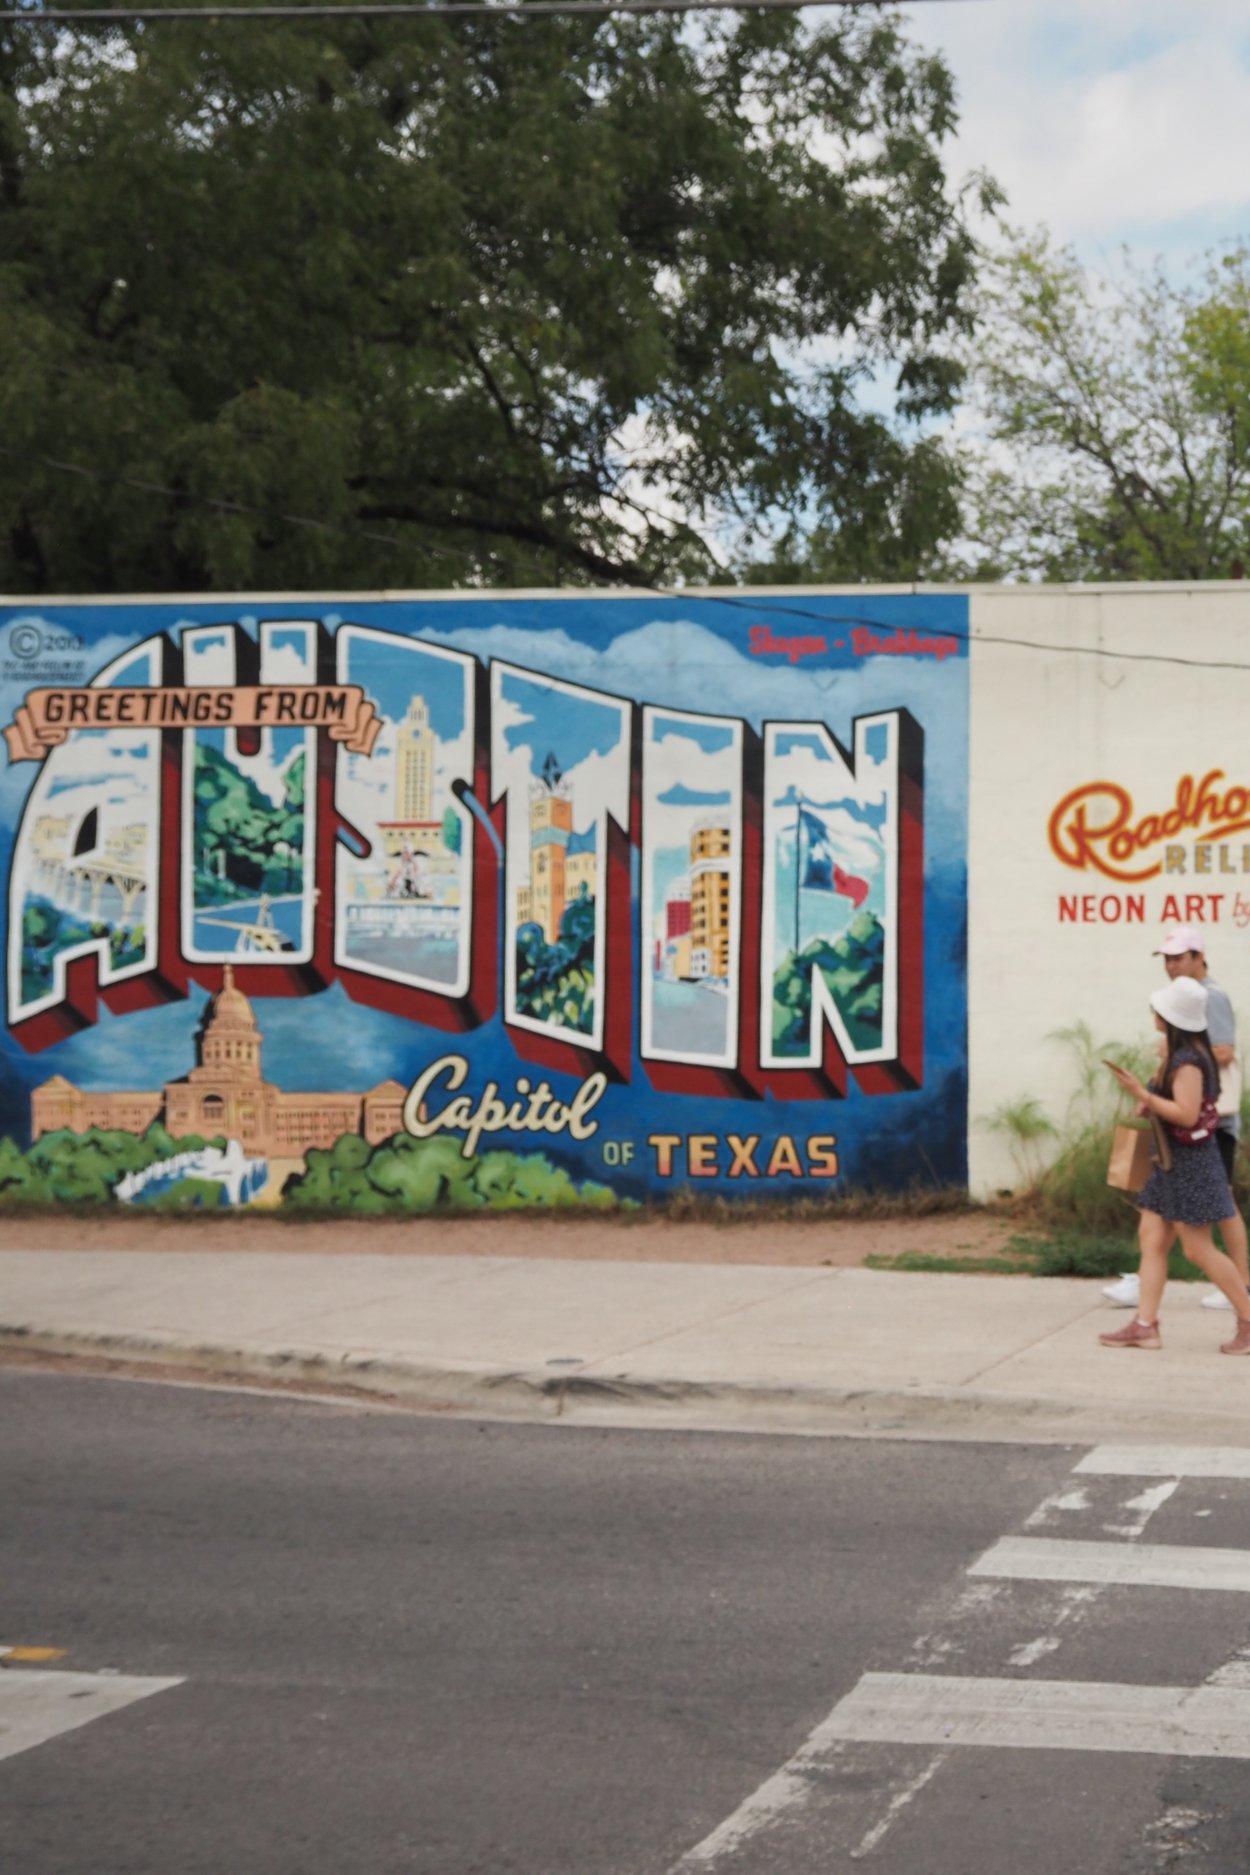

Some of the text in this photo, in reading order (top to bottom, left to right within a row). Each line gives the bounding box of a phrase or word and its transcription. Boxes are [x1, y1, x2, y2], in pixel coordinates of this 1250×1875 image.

[44, 691, 347, 723] GREETINGS FROM
[6, 616, 905, 1078] AUSTIN
[1058, 895, 1146, 923] NEON
[1160, 894, 1225, 923] ART
[403, 1055, 607, 1158] Capitol
[603, 1135, 840, 1178] OF TEXAS
